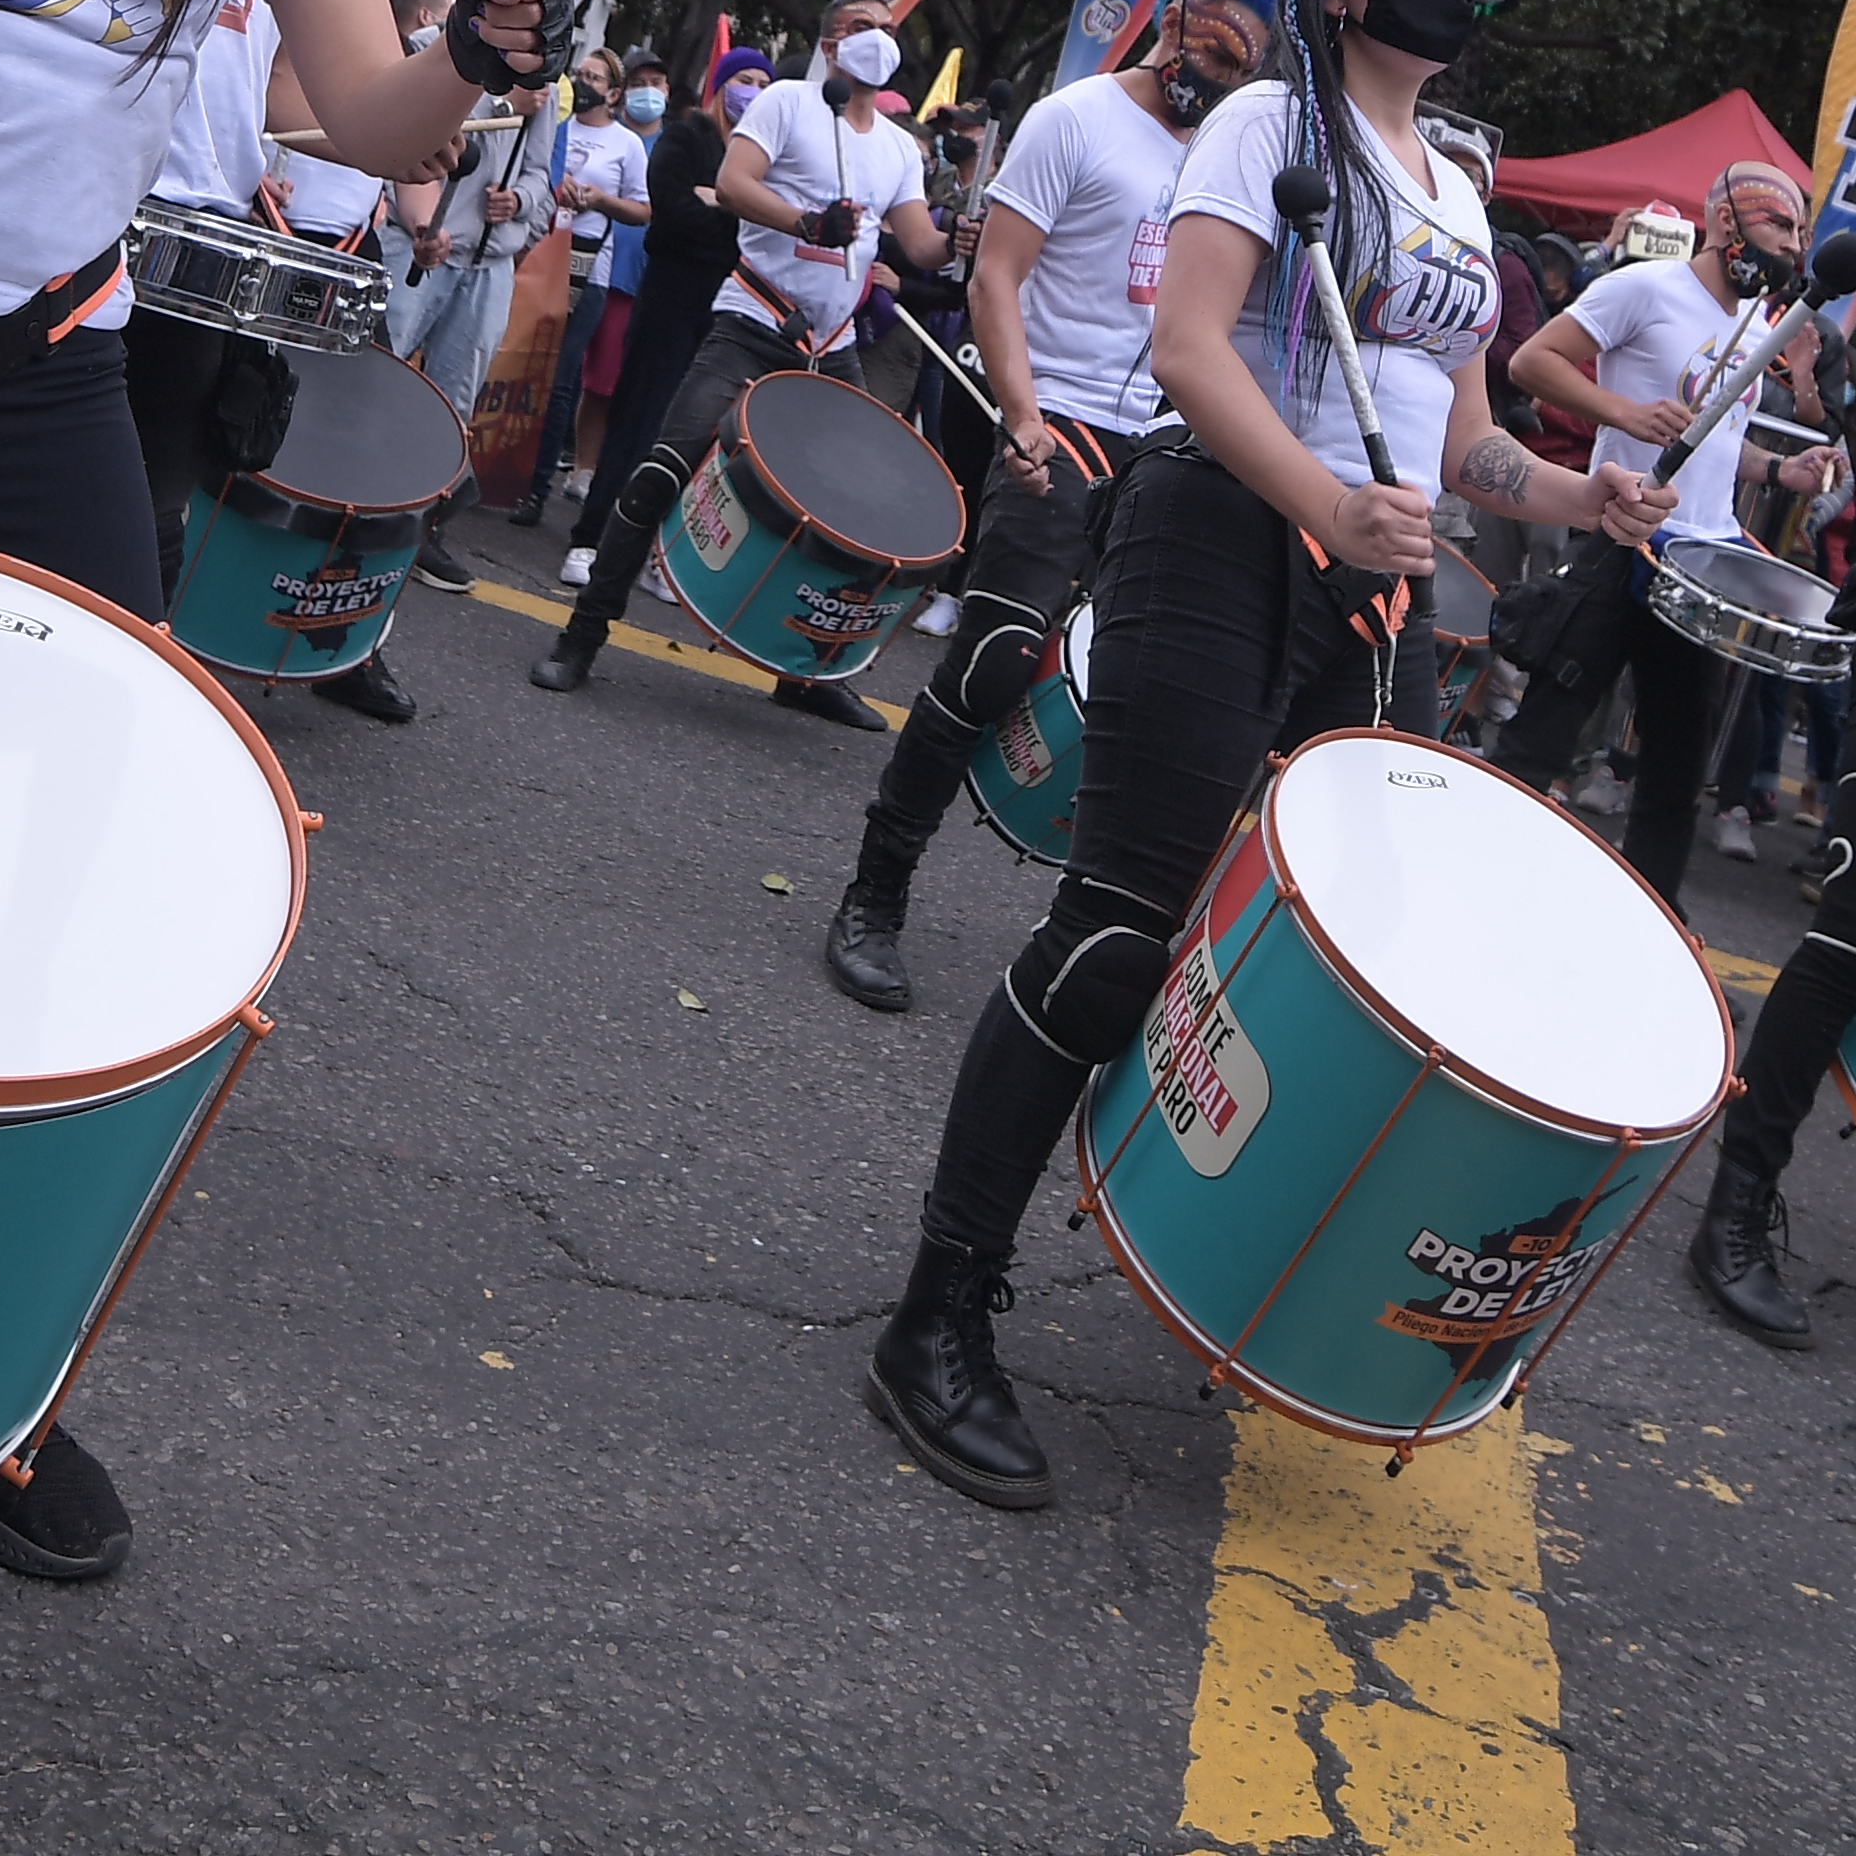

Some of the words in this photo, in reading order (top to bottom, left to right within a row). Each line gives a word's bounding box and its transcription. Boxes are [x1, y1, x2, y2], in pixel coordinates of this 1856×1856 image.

[1137, 222, 1155, 243] ES
[1130, 265, 1152, 286] DE
[1394, 261, 1482, 338] CUT
[271, 565, 406, 598] PROYECTOS
[294, 598, 332, 615] DE
[332, 590, 379, 613] LEY
[795, 582, 905, 618] PROYECTOS
[809, 611, 841, 631] DE
[840, 617, 880, 632] LEY
[1185, 946, 1236, 1063] COMTÉ
[1147, 1007, 1167, 1059] DE
[1153, 1052, 1197, 1136] PARO
[1407, 1228, 1606, 1287] PROYECT
[1440, 1286, 1512, 1318] DE
[1511, 1271, 1582, 1314] LEY
[1393, 1310, 1439, 1337] Pliego
[1443, 1323, 1492, 1340] Nacion
